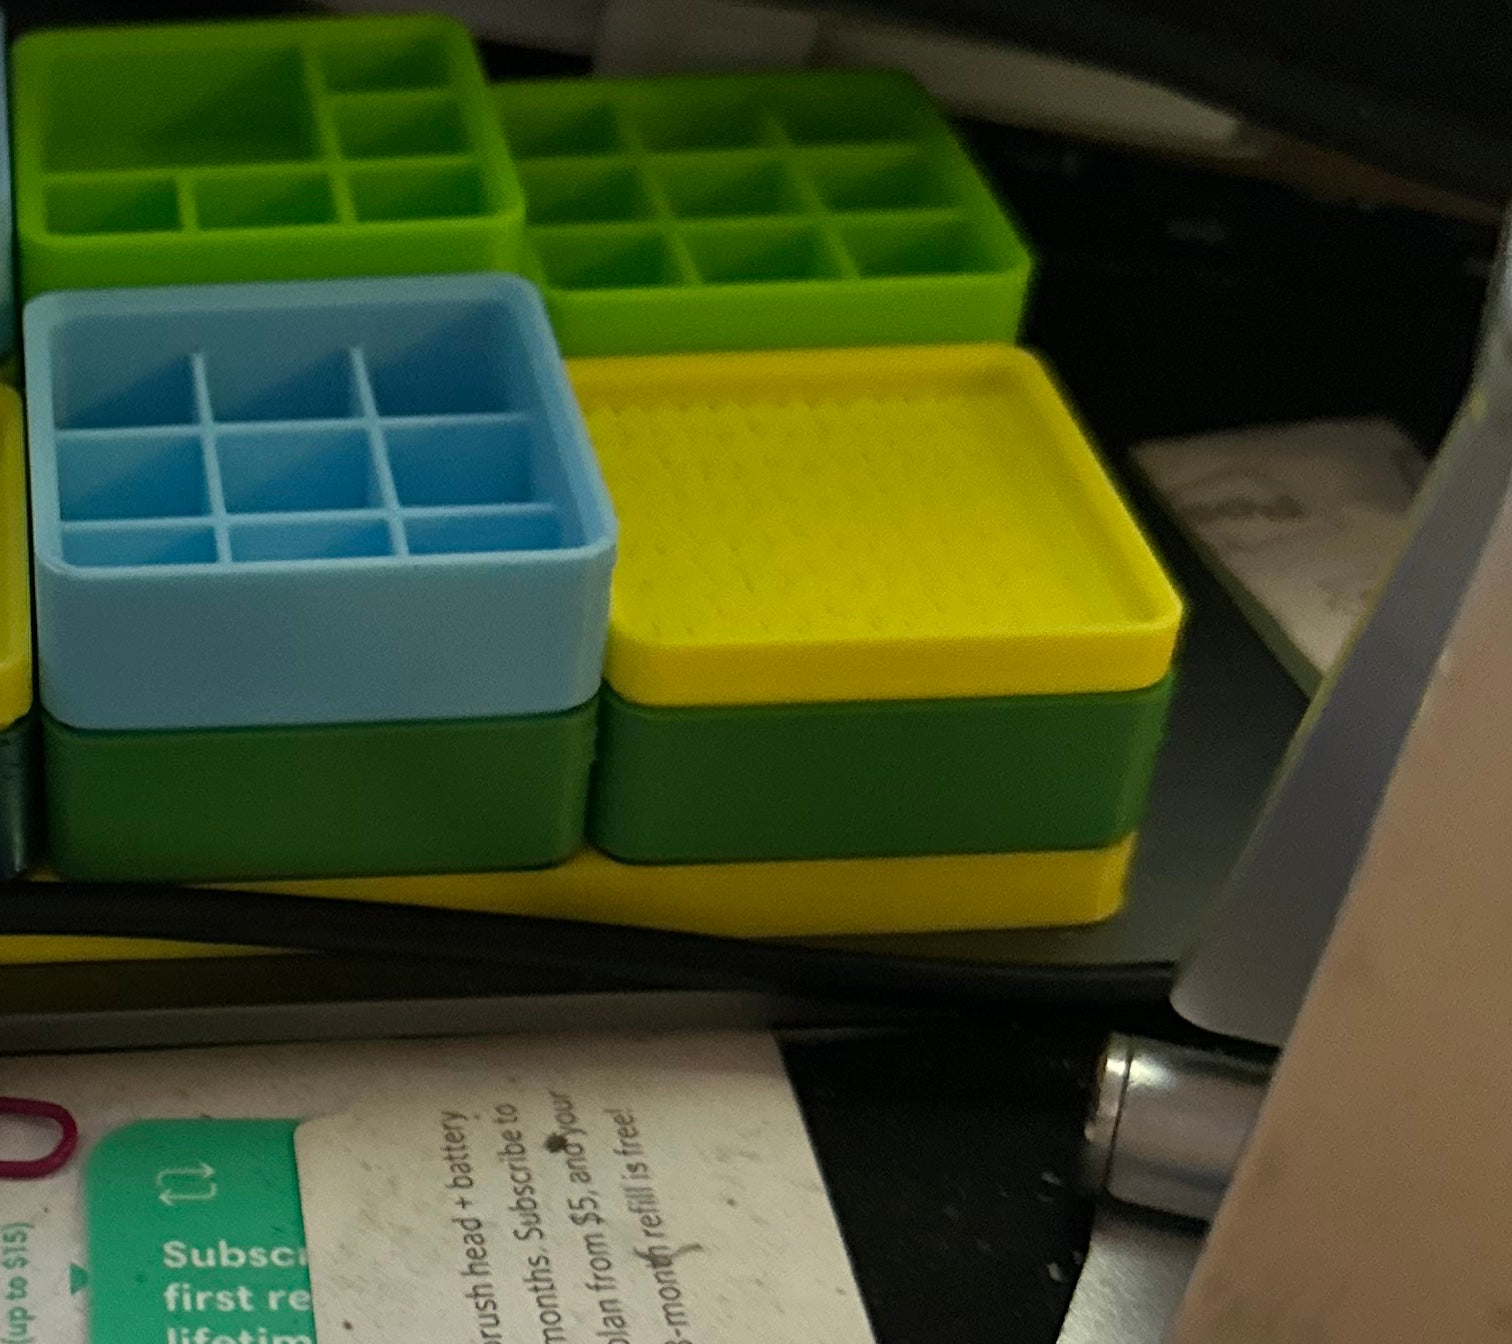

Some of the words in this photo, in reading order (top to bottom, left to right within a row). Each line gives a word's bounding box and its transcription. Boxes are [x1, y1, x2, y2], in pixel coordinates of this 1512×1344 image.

[494, 1103, 517, 1125] to
[549, 1091, 588, 1138] your
[441, 1109, 474, 1190] battery
[550, 1138, 591, 1184] and
[622, 1161, 649, 1182] is
[498, 1128, 544, 1241] Subscribe
[624, 1184, 666, 1239] refill
[1, 1220, 35, 1269] $15)
[452, 1216, 492, 1278] head
[583, 1233, 620, 1295] from
[2, 1273, 29, 1301] to
[163, 1282, 255, 1312] first
